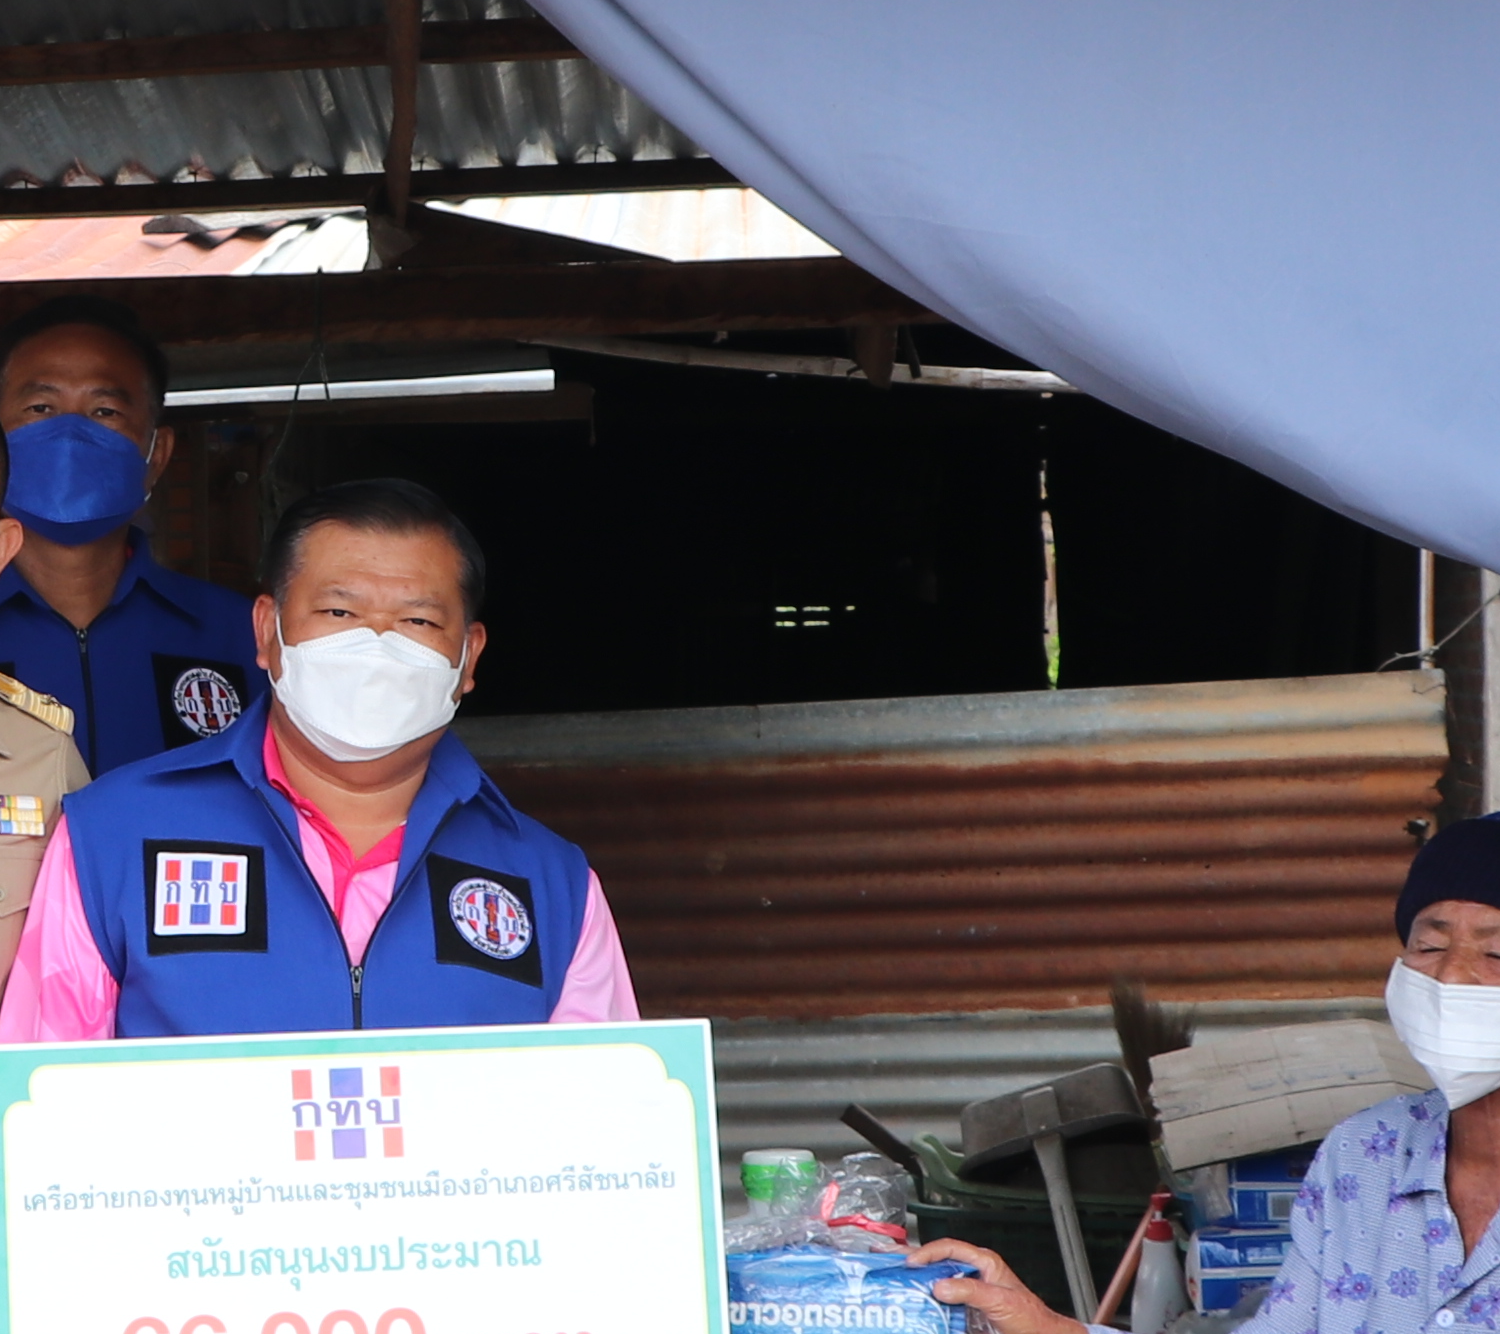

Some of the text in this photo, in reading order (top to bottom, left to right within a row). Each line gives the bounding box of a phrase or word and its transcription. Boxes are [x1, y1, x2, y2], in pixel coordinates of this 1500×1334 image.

[166, 881, 238, 904] กทบ
[292, 1096, 401, 1128] กทบ
[23, 1162, 676, 1217] เครือข่ายกองทุนหมู่บ้านและชุมชนเมืองอำเภอศรีสัชนาลัย
[166, 1235, 543, 1292] สนับสนุนงบประมาณ
